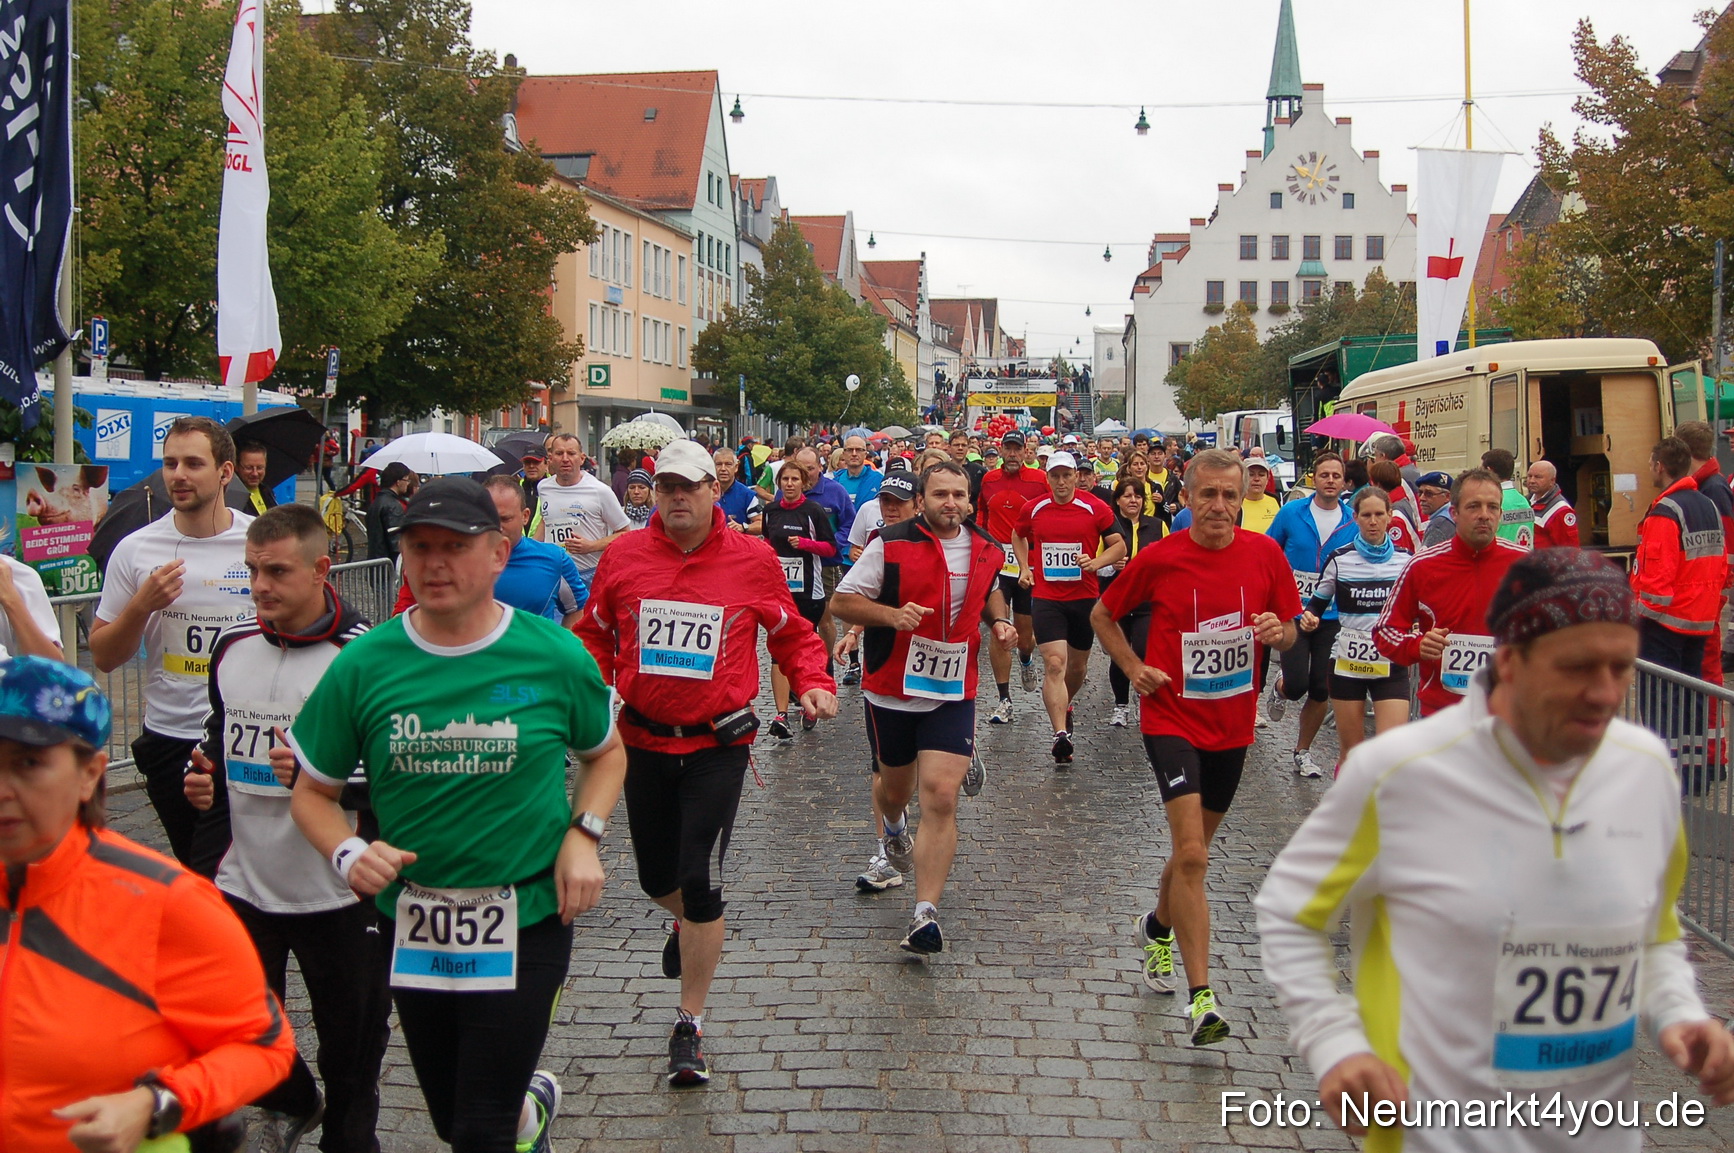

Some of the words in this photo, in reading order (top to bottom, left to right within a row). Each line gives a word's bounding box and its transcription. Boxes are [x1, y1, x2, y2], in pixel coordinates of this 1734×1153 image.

[225, 148, 252, 172] ÖGL
[95, 323, 105, 352] P
[330, 352, 338, 375] P
[591, 367, 607, 384] D
[995, 395, 1027, 404] START
[1415, 391, 1465, 419] Bayerisches
[1414, 420, 1438, 440] Rotes
[1415, 443, 1436, 462] Kreuz
[25, 538, 48, 549] BEIDE
[49, 532, 91, 546] STIMMEN
[551, 527, 574, 543] 160
[46, 545, 70, 555] GRÜN
[1007, 551, 1015, 564] 5
[1045, 552, 1078, 566] 3109
[61, 566, 82, 577] UND
[784, 566, 800, 579] 17
[62, 572, 99, 594] DU?
[1296, 580, 1313, 596] 24
[1350, 587, 1391, 598] Triathl
[162, 609, 190, 621] PARTL
[191, 613, 234, 623] Neumarkt
[641, 606, 668, 616] PARTL
[669, 608, 709, 620] Neumarkt
[1210, 619, 1230, 630] DEHN
[646, 618, 713, 651] 2176
[1183, 639, 1210, 647] PARTL
[1211, 635, 1244, 646] Neumarkt
[1340, 631, 1356, 640] PARTL
[911, 640, 934, 652] PARTL
[1347, 641, 1380, 662] 523
[184, 660, 210, 673] Mart
[655, 652, 696, 667] Michael
[911, 650, 962, 679] 3111
[1191, 643, 1249, 675] 2305
[1449, 649, 1490, 671] 220
[1349, 663, 1374, 673] Sandra
[1209, 679, 1234, 691] Franz
[1456, 677, 1468, 687] An
[225, 707, 248, 720] PARTL
[249, 710, 291, 722] Neumarkt
[389, 713, 428, 741] 30.
[230, 722, 289, 760] 271
[389, 739, 518, 755] REGENSBURGER
[391, 753, 518, 775] Altstadtlauf
[243, 766, 275, 783] Richar
[404, 888, 438, 902] PARTL
[439, 892, 495, 908] Neumarkt
[407, 903, 505, 946] 2052
[1502, 942, 1560, 957] PARTL
[430, 955, 478, 974] Albert
[1513, 959, 1638, 1026] 2674
[1537, 1038, 1614, 1065] Rüdiger
